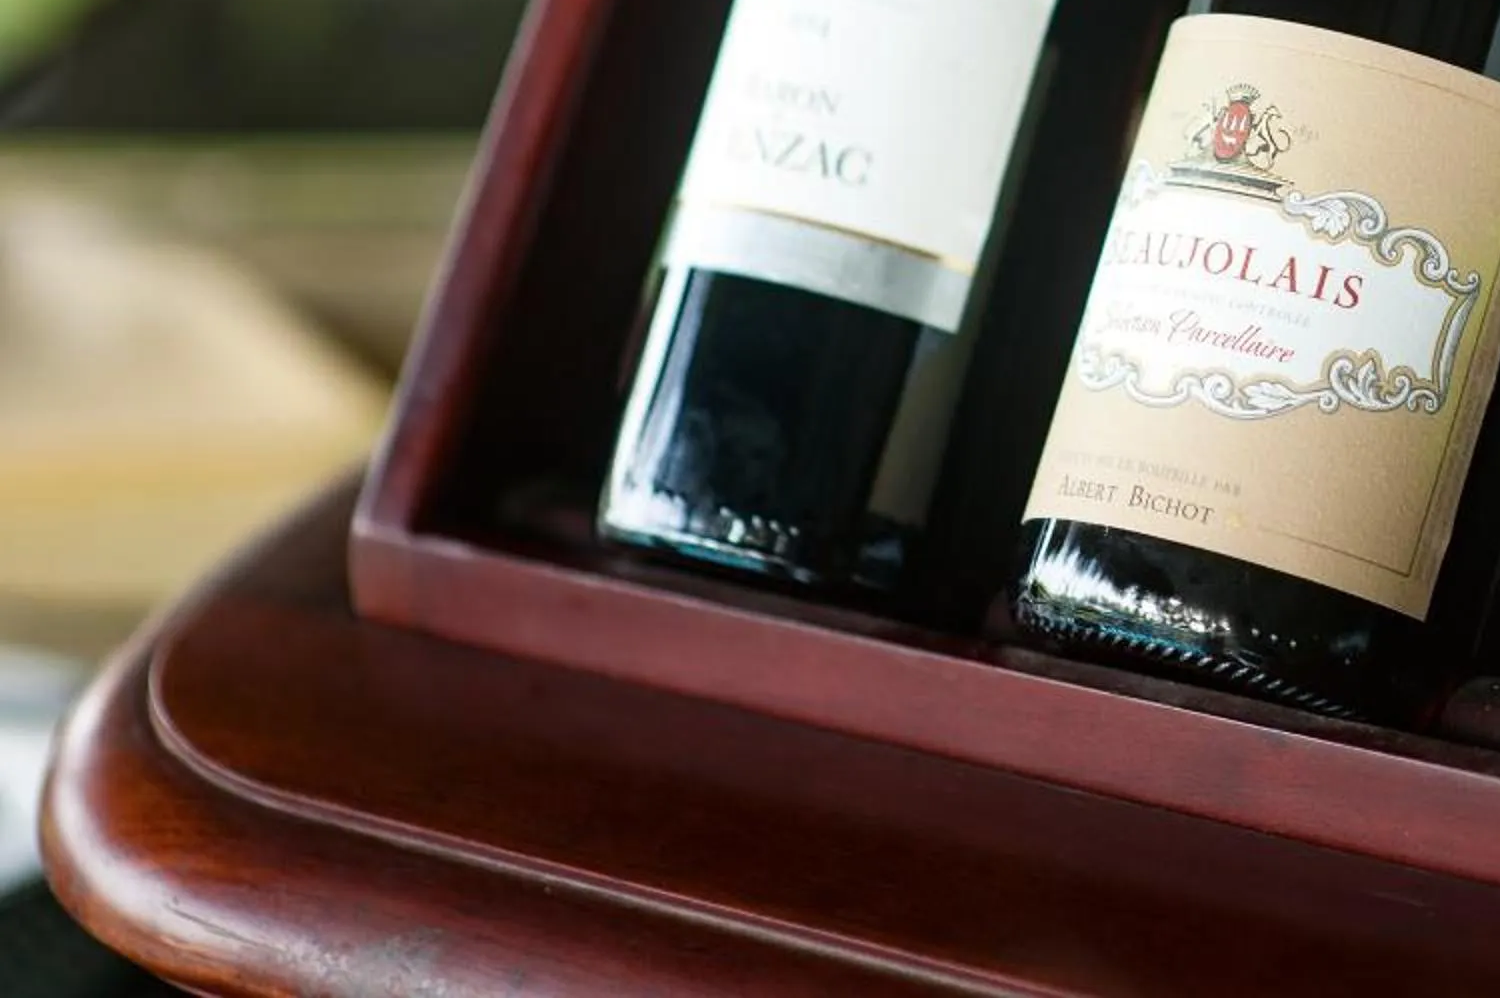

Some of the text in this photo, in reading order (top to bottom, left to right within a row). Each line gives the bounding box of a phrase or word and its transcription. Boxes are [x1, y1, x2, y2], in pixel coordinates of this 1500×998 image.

[747, 74, 844, 116] ARON
[728, 125, 874, 187] NZAC
[1167, 308, 1296, 363] Parcellaire
[1057, 473, 1215, 525] ALBERT BICHOT
